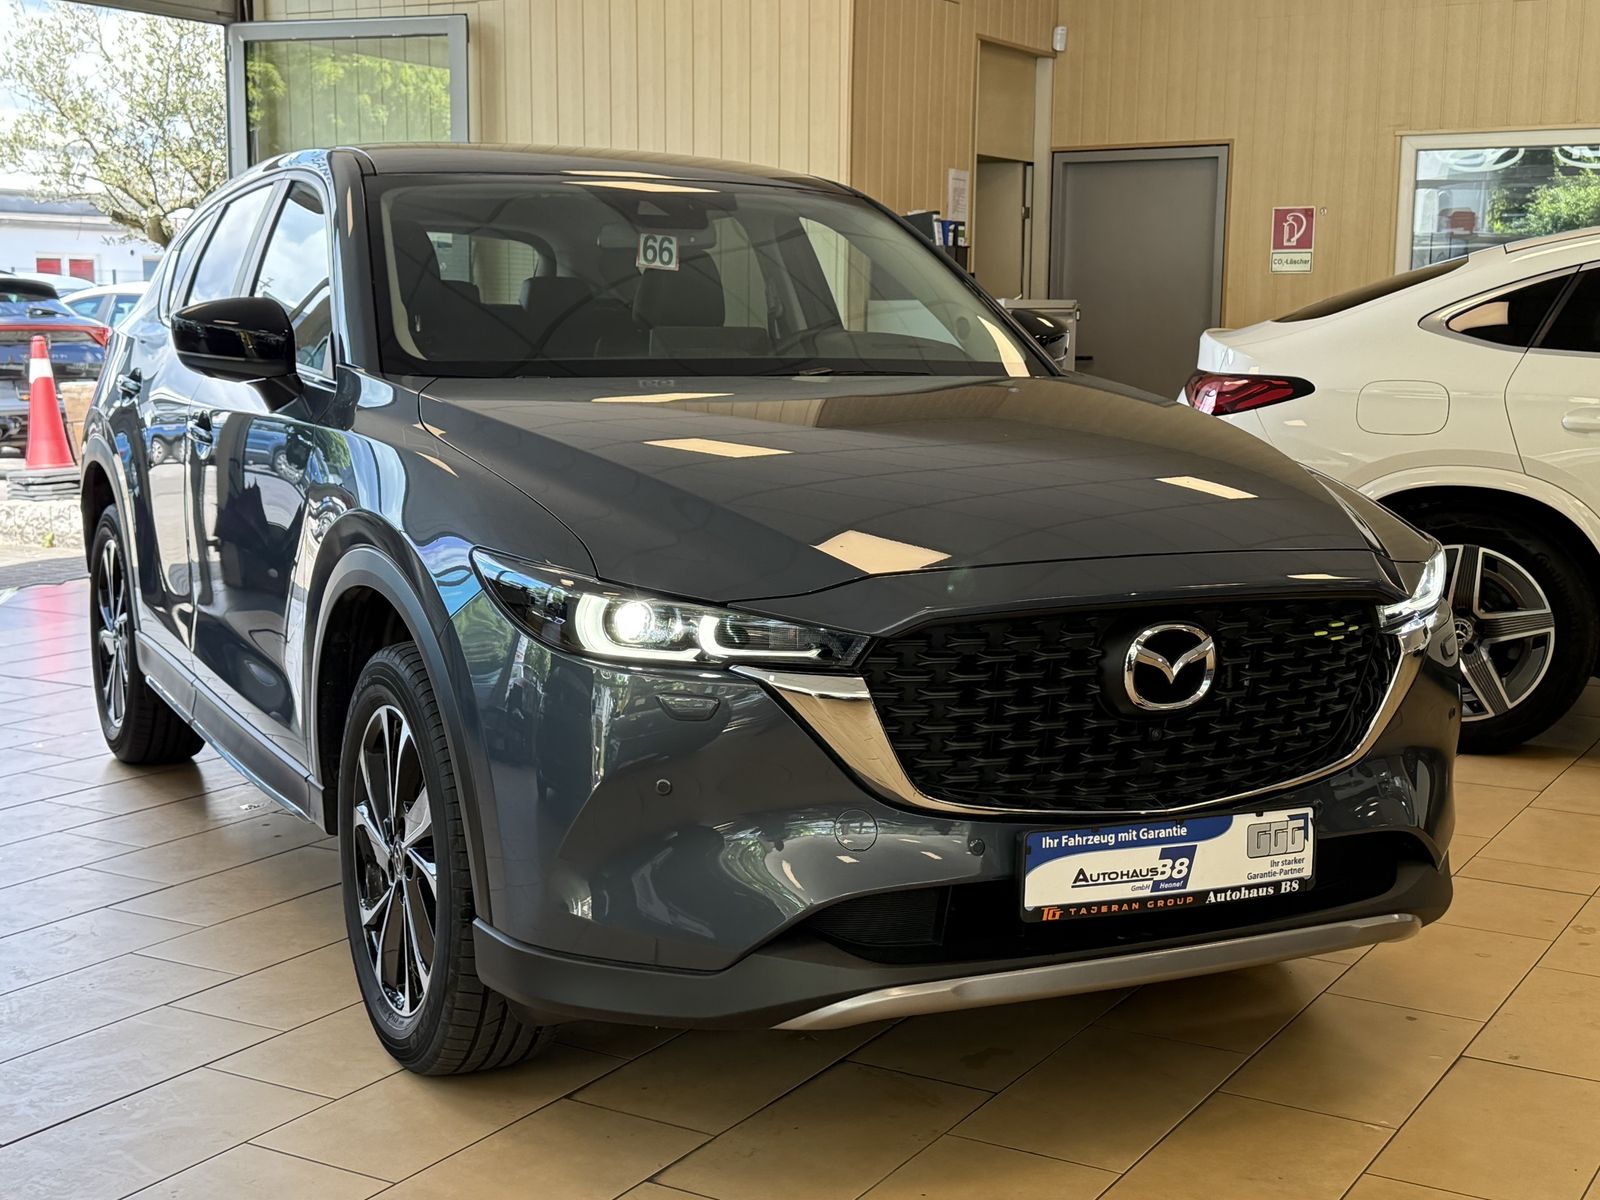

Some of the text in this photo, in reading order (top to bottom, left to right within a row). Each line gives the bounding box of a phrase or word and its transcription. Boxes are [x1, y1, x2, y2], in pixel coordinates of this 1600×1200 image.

[643, 235, 673, 265] 66
[1042, 825, 1187, 849] Ihr Fahrzeug mit Garantie
[1270, 857, 1305, 868] Ihr starker
[1247, 867, 1304, 881] Garantie-Partner
[1131, 883, 1151, 892] GmbH
[1205, 880, 1300, 904] Autohaus B8
[1069, 902, 1140, 916] TAJERAN
[1147, 896, 1194, 909] GROUP
